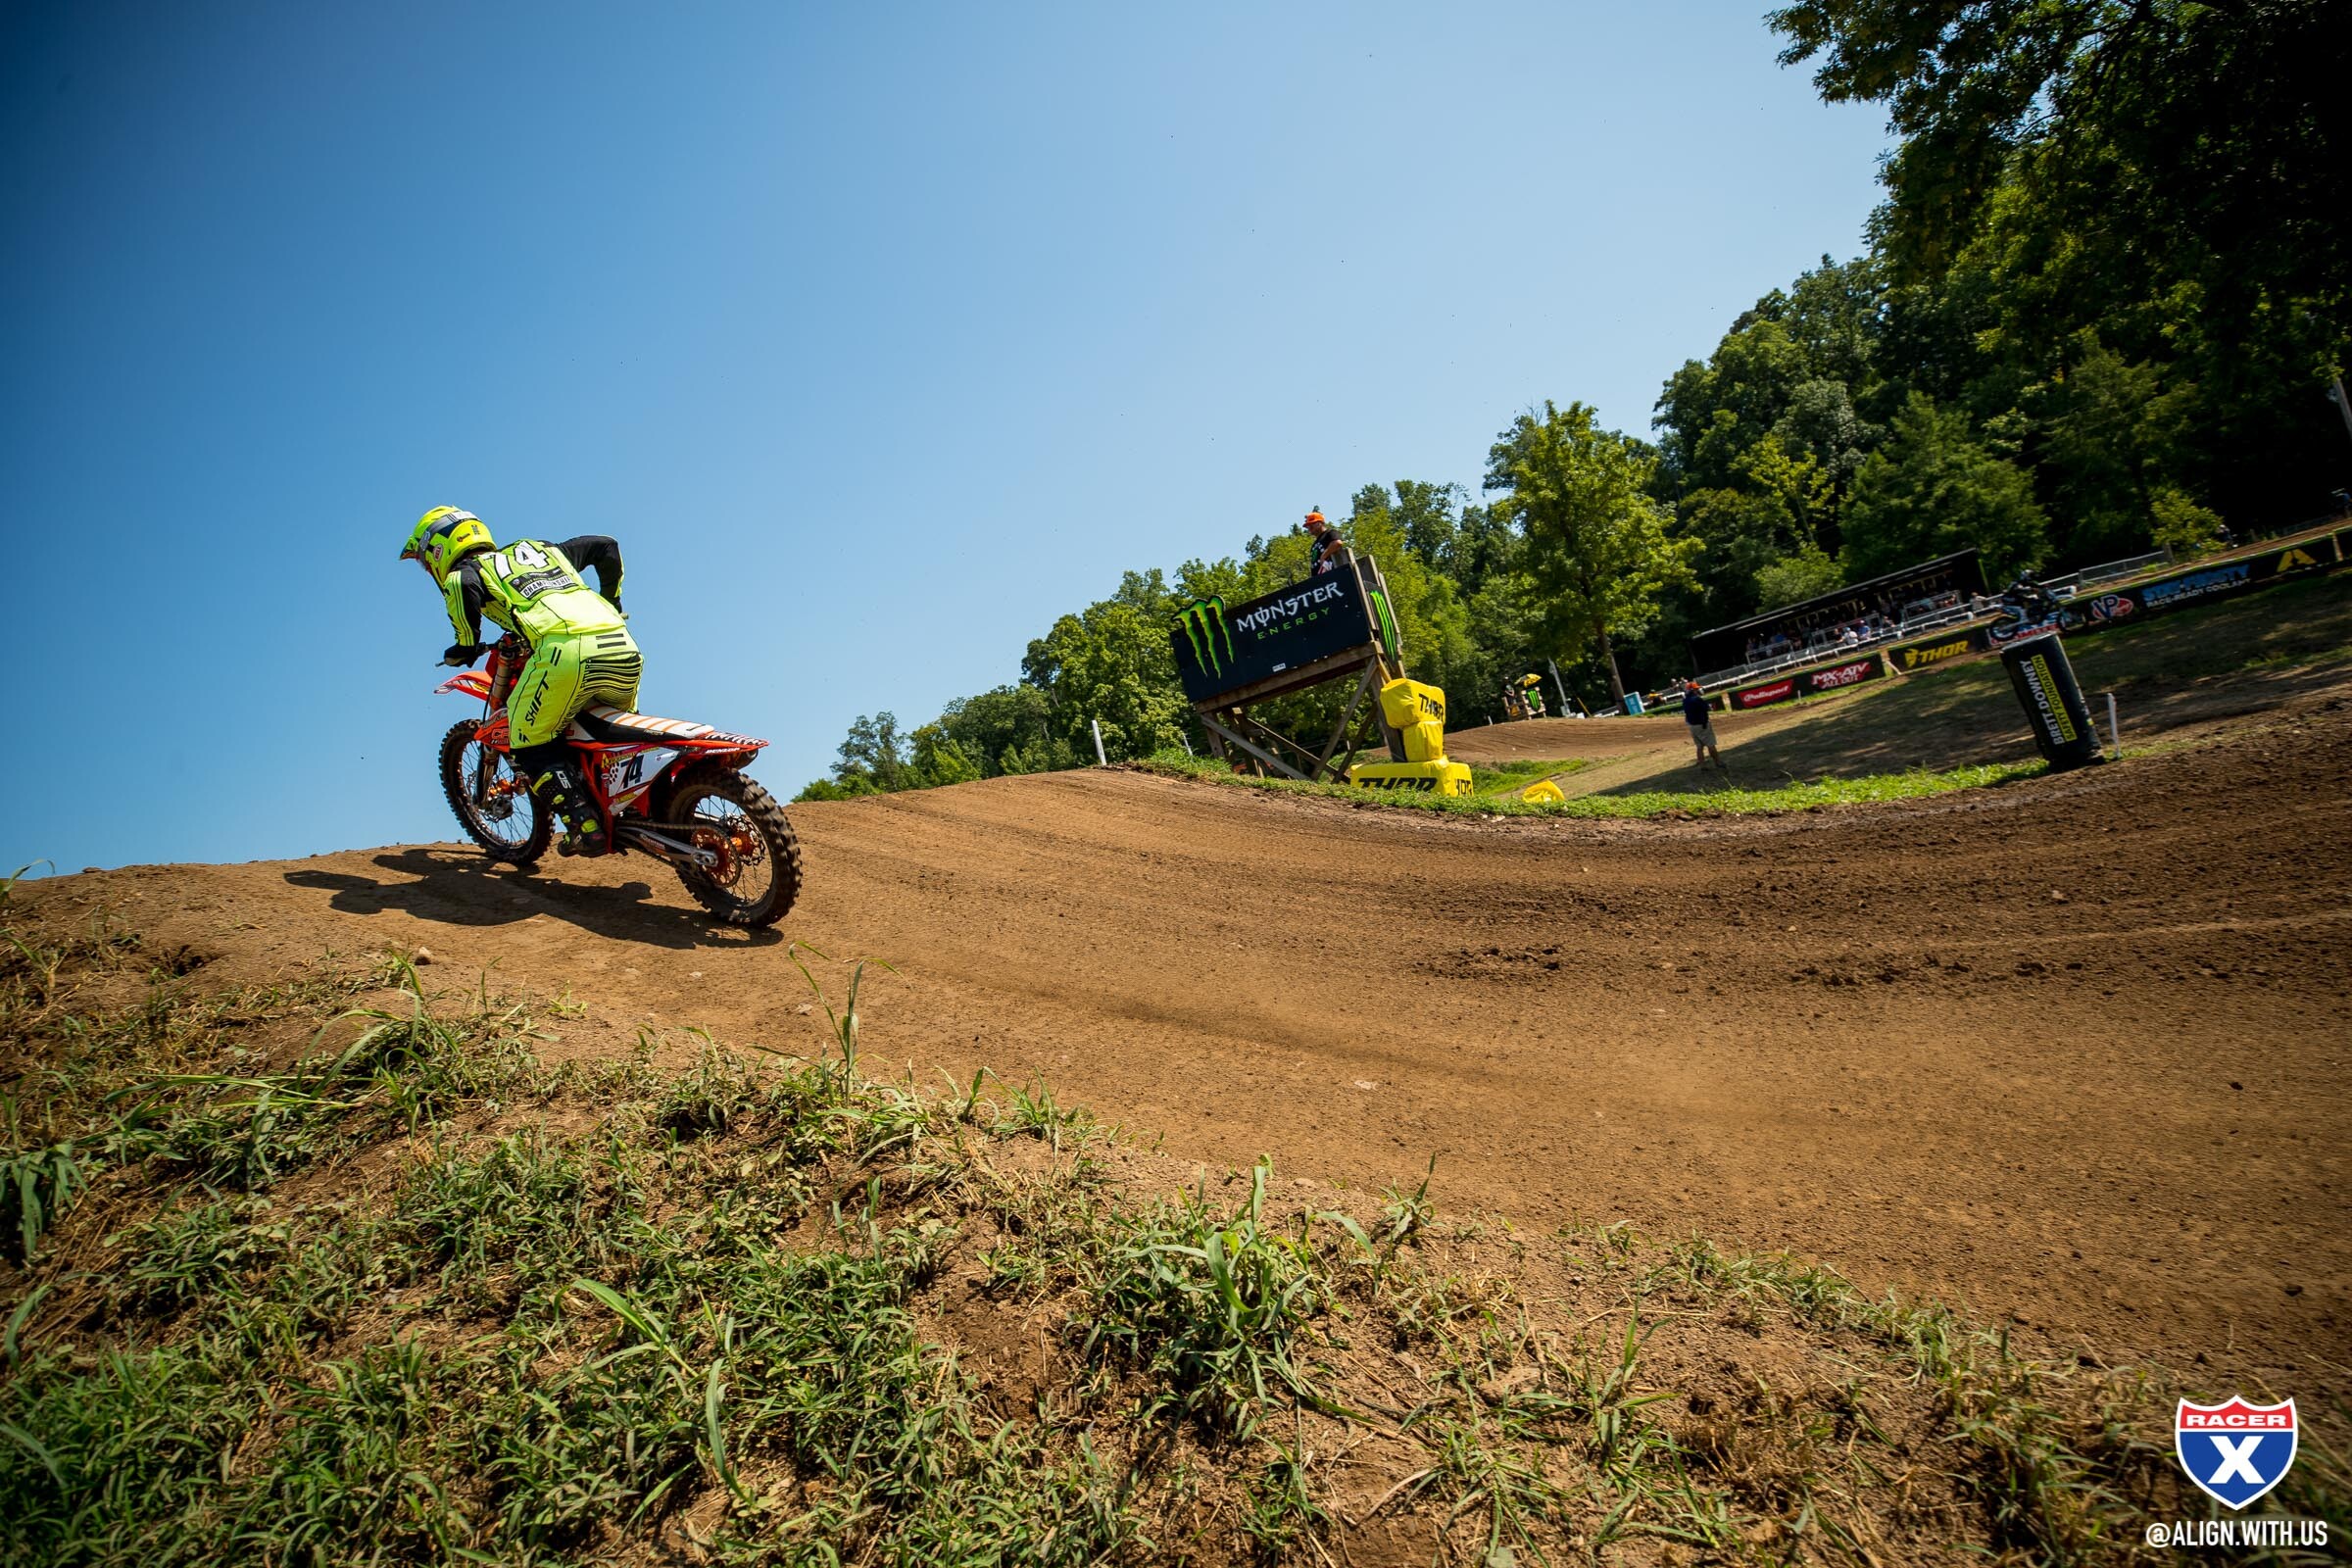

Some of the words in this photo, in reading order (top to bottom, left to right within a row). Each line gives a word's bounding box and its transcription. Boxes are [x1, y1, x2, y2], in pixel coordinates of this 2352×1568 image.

[483, 541, 549, 581] 74
[1236, 582, 1344, 632] MONSTER
[1256, 608, 1330, 640] ENERGY
[1920, 640, 1968, 662] THOR
[525, 670, 549, 726] SHIFT
[2020, 661, 2049, 710] DOWNEY
[2034, 657, 2062, 710] FOUNDATION
[2042, 712, 2066, 745] BRETT
[2058, 712, 2077, 740] SAFETY
[620, 755, 644, 789] 74
